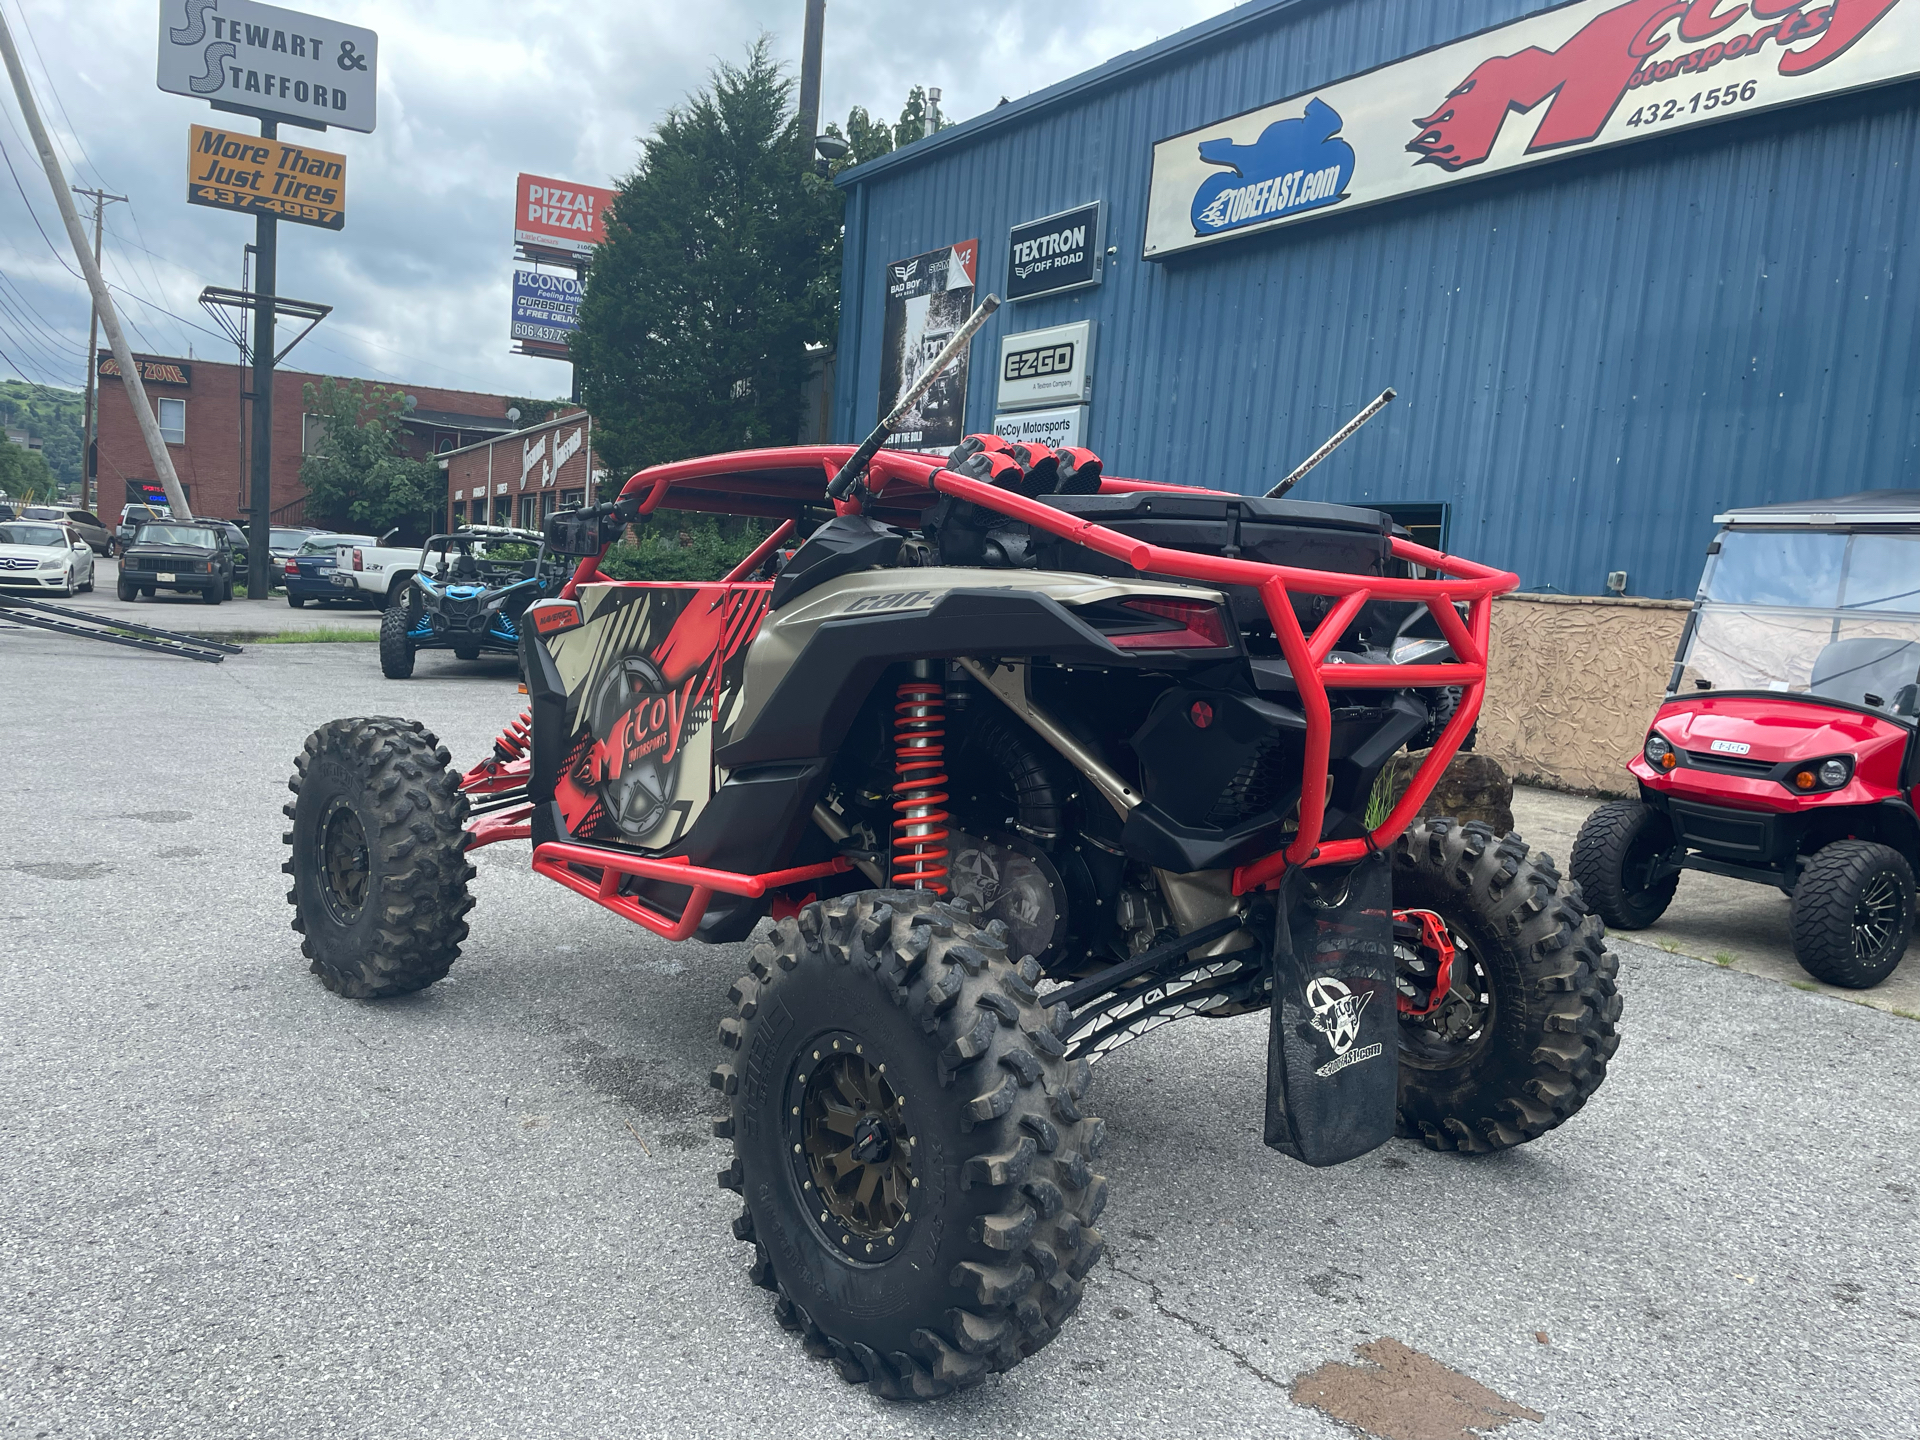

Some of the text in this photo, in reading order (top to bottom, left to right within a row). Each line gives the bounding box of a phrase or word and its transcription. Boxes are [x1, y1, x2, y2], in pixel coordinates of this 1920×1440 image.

[337, 40, 368, 72] &
[189, 41, 347, 111] STAFFORD
[1626, 79, 1757, 128] 432-1556
[197, 131, 342, 180] More Than
[198, 160, 338, 205] Just Tires
[197, 187, 337, 223] 437-4997
[529, 184, 595, 213] PIZZA!
[528, 204, 594, 233] PIZZA!
[1013, 225, 1086, 264] TEXTRON
[1034, 251, 1084, 273] OFF ROAD
[518, 271, 587, 296] ECONOM
[537, 289, 584, 303] Feeling bette
[890, 279, 921, 294] BAD BOY
[517, 295, 574, 315] CURBSIDE
[517, 308, 578, 325] & FREE DELIV
[515, 323, 566, 341] 606.437.7
[144, 362, 188, 384] ZONE
[1006, 346, 1071, 378] EZGO
[1053, 380, 1073, 388] Company
[996, 419, 1070, 437] McCoy Motorsports
[540, 609, 573, 625] MAVERICK
